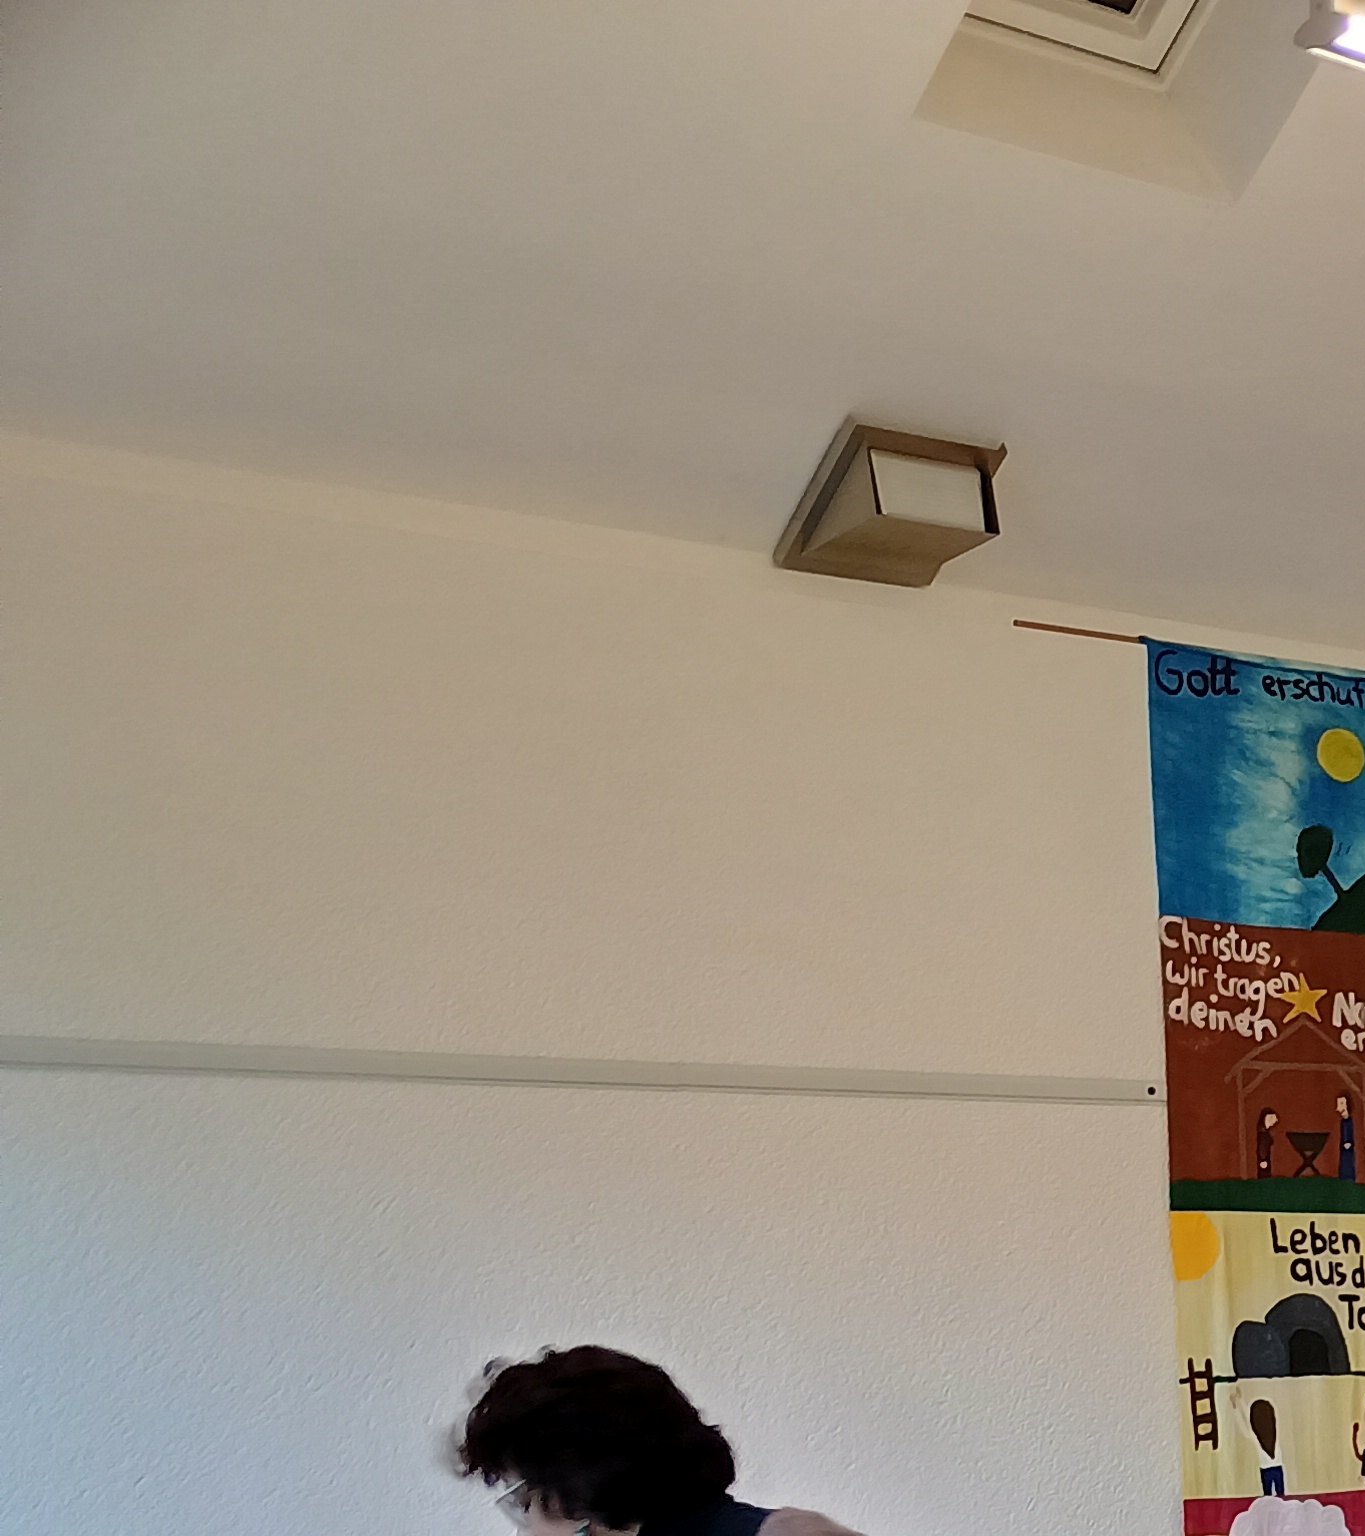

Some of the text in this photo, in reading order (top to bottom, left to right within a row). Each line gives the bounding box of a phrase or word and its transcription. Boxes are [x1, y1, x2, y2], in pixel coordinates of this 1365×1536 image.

[1154, 650, 1241, 698] Gott
[1158, 915, 1282, 968] Christus,
[1165, 956, 1300, 1022] wir tragen
[1168, 986, 1278, 1043] deinen
[1269, 1217, 1362, 1256] Leben
[1289, 1256, 1348, 1287] aus
